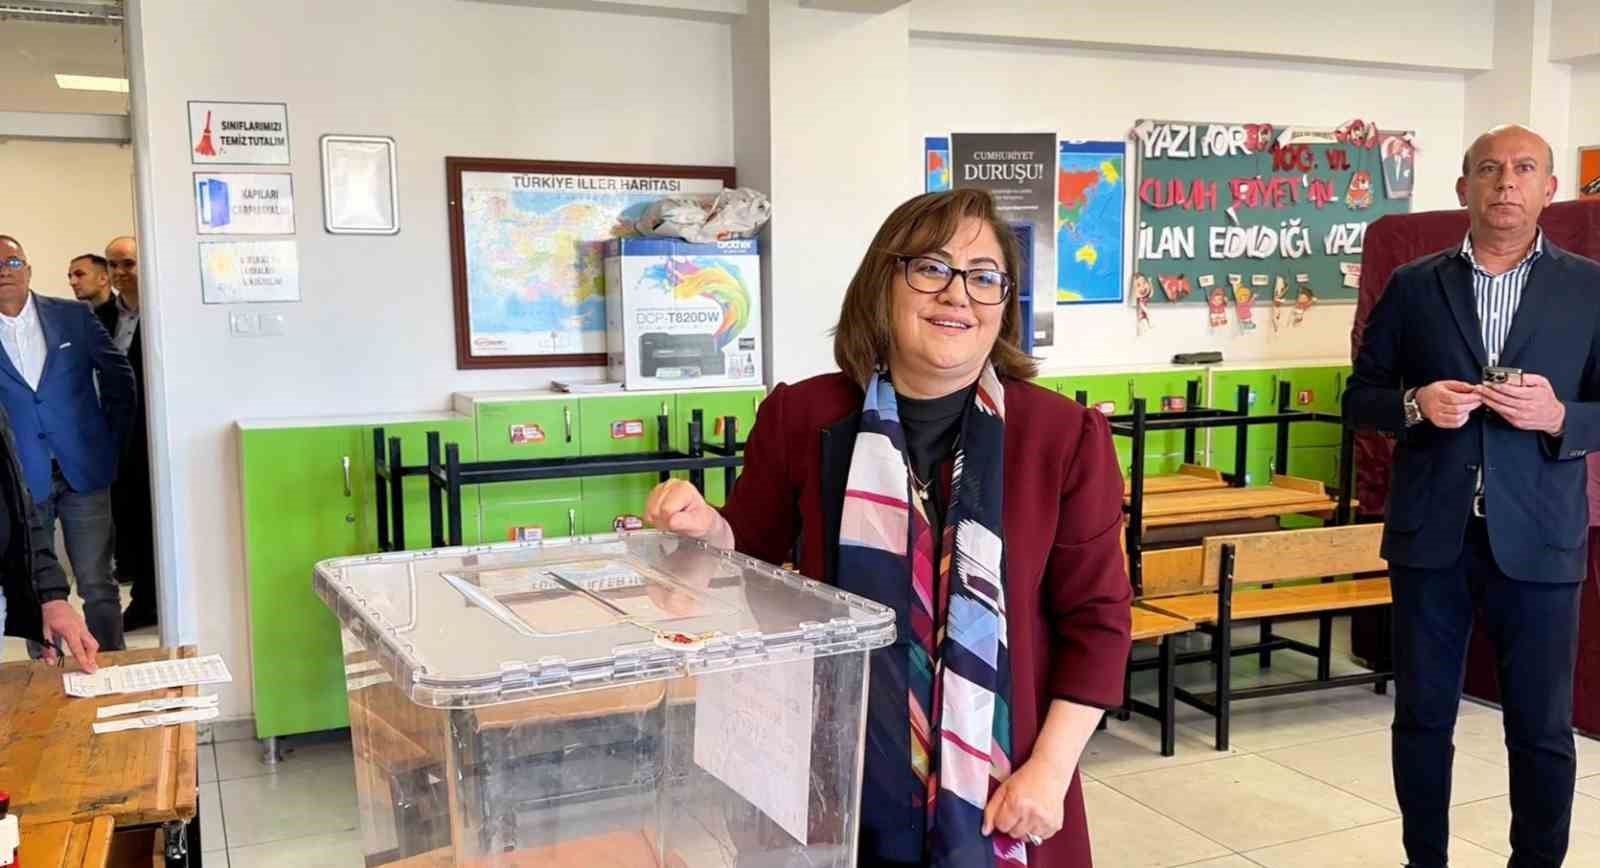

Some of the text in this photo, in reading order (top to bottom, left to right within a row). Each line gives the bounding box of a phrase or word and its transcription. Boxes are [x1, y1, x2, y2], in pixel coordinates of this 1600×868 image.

[221, 120, 282, 131] SINIFLARIMIZI
[220, 134, 285, 146] TEMİZ TUTALIM
[974, 150, 1034, 161] CUMHURİYET
[964, 163, 1044, 184] DURUŞU!
[512, 174, 573, 190] TÜRKİYE
[621, 177, 681, 192] HARİTASI
[1138, 221, 1195, 259] İLAN
[636, 311, 720, 324] DCP-T820DW
